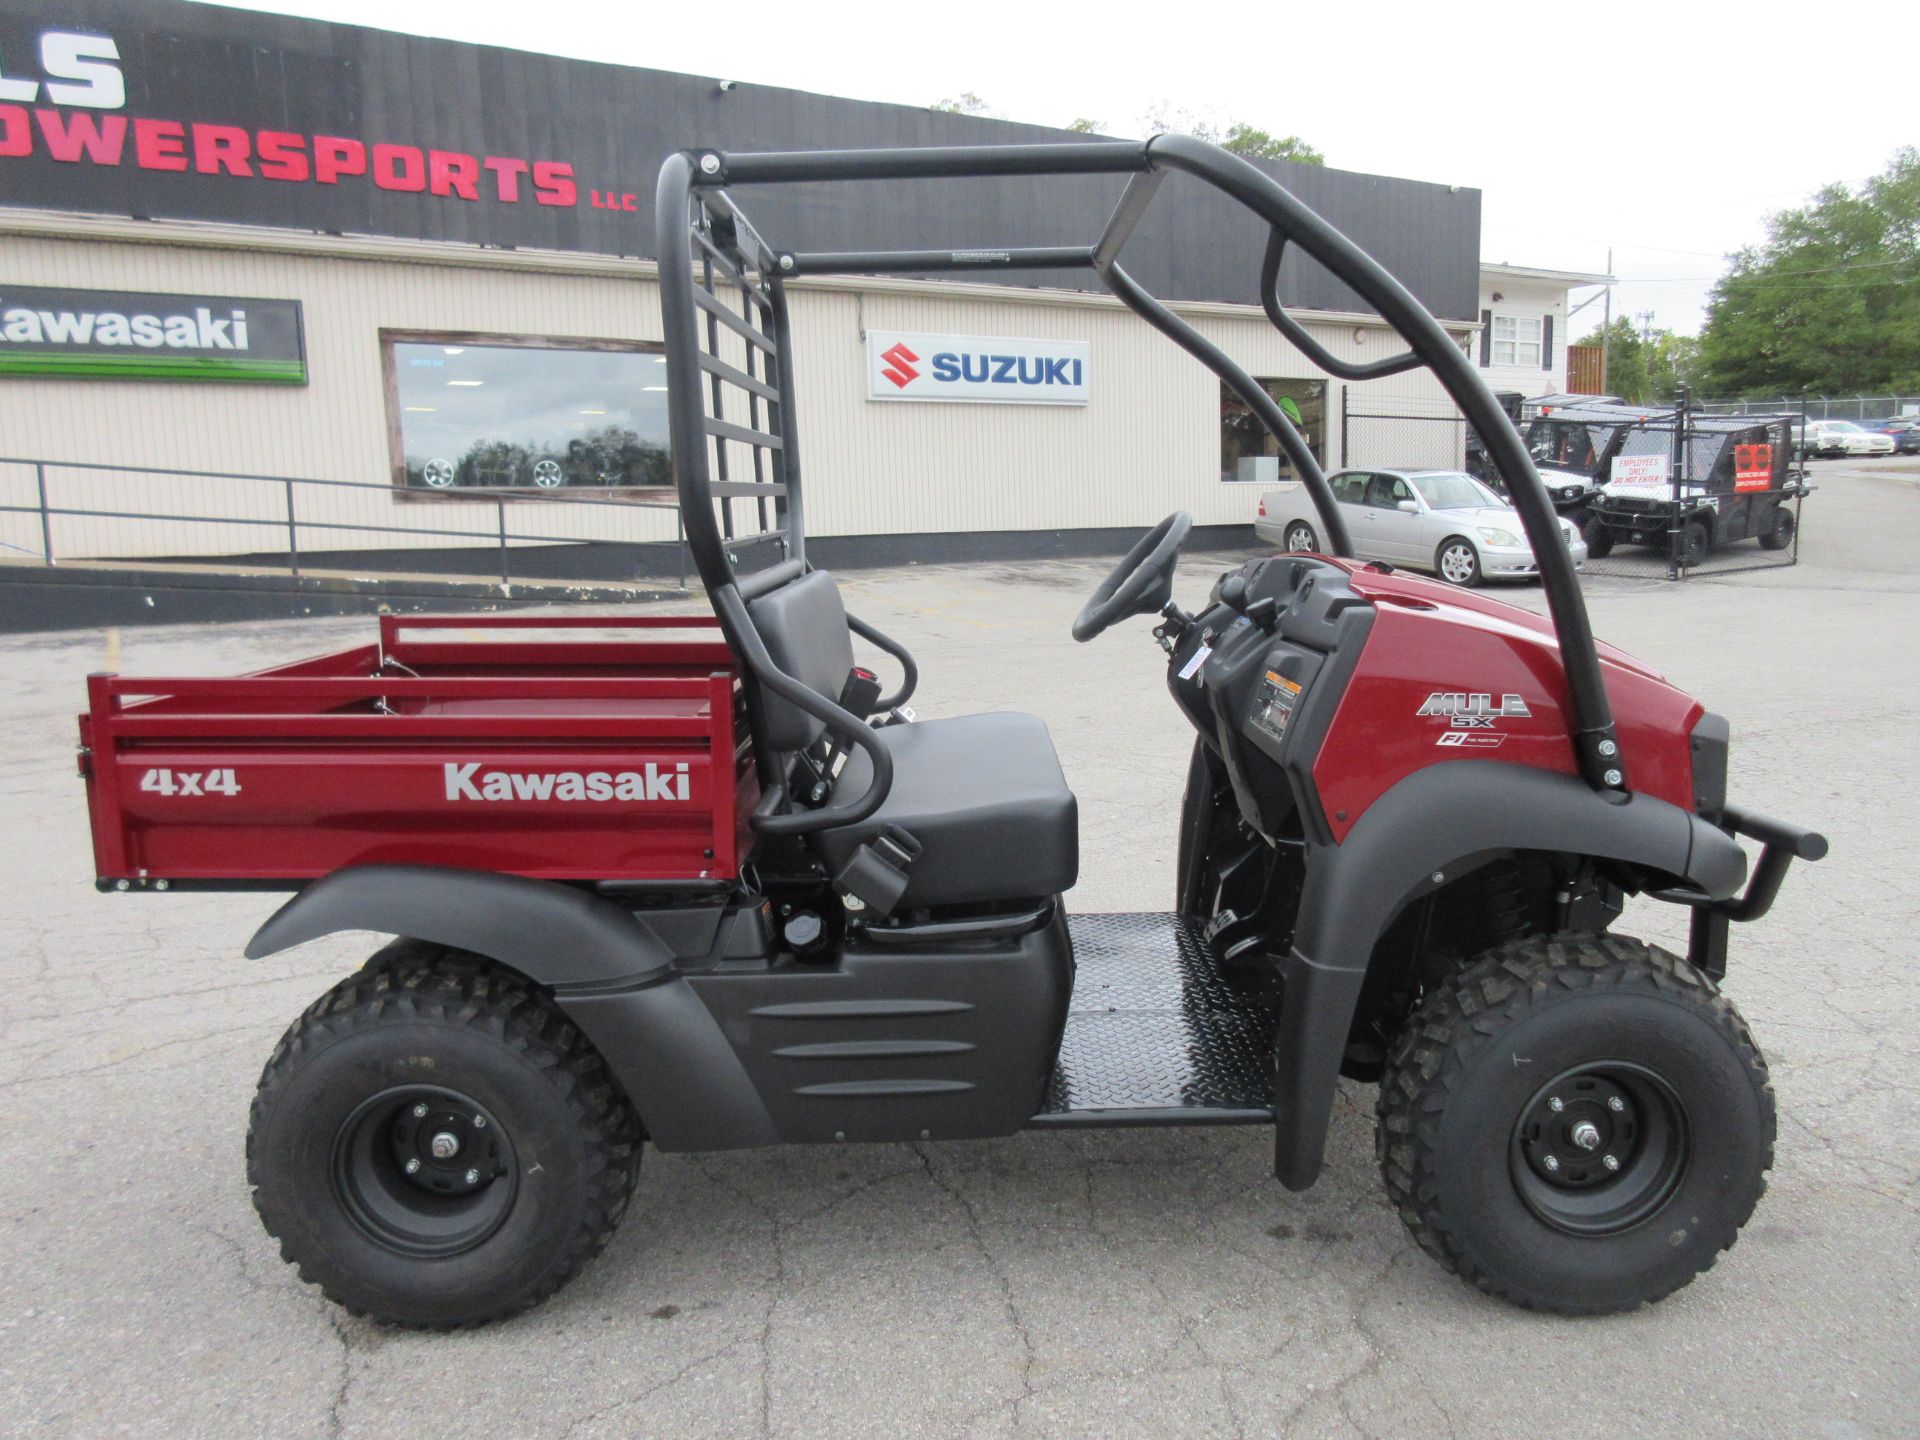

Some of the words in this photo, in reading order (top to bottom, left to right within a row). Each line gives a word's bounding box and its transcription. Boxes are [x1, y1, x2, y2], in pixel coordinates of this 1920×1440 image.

[591, 190, 637, 212] LLC
[0, 307, 249, 350] awasaki
[932, 352, 1082, 386] SUZUKI
[1619, 458, 1659, 467] EMPLOYEES
[1628, 467, 1648, 476] ONLY!
[1624, 476, 1637, 484] NOT
[1416, 693, 1532, 717] MULE
[1451, 716, 1496, 728] SX
[140, 768, 242, 797] 4x4
[444, 763, 690, 801] Kawasaki
